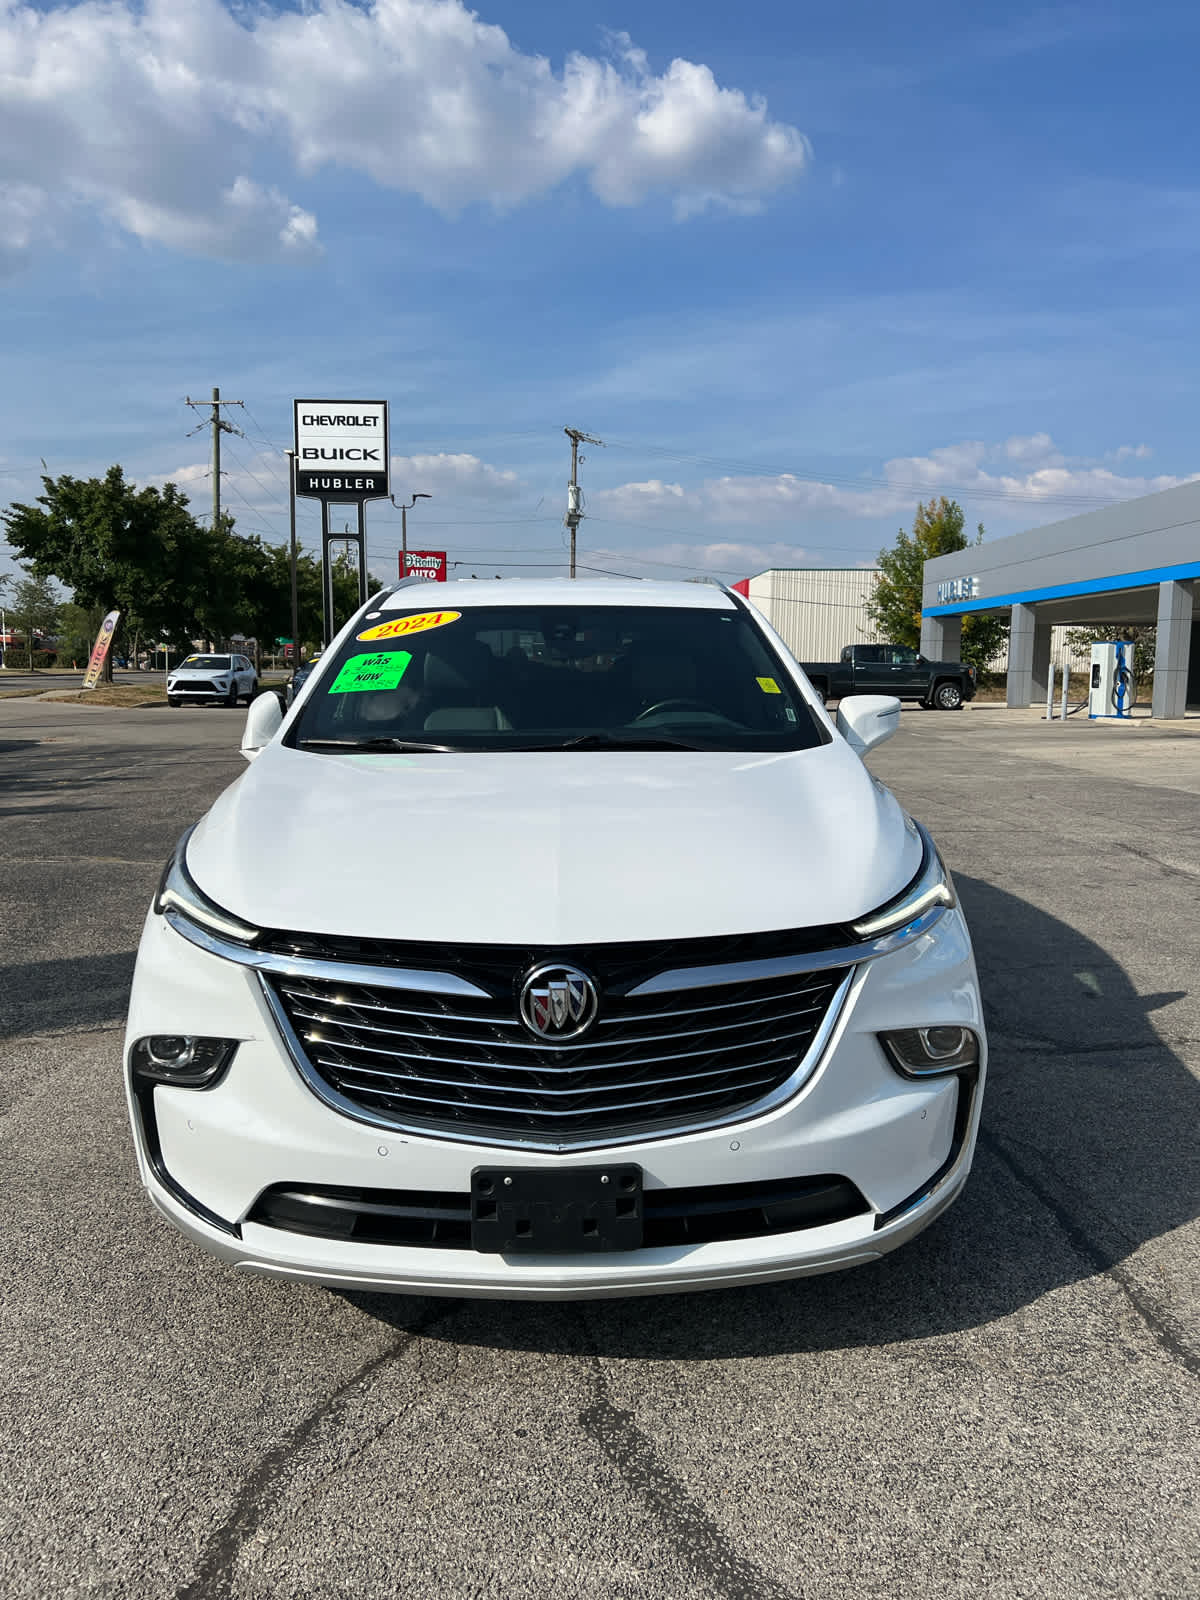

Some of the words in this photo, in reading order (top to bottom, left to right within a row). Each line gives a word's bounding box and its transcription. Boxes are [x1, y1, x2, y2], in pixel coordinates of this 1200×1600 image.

[302, 415, 379, 427] CHEVROLET
[302, 448, 381, 461] BUICK
[309, 478, 375, 489] HUBLER
[410, 569, 437, 579] AUTO
[376, 613, 443, 639] 2024
[362, 657, 393, 667] WAS
[353, 672, 384, 682] NOW
